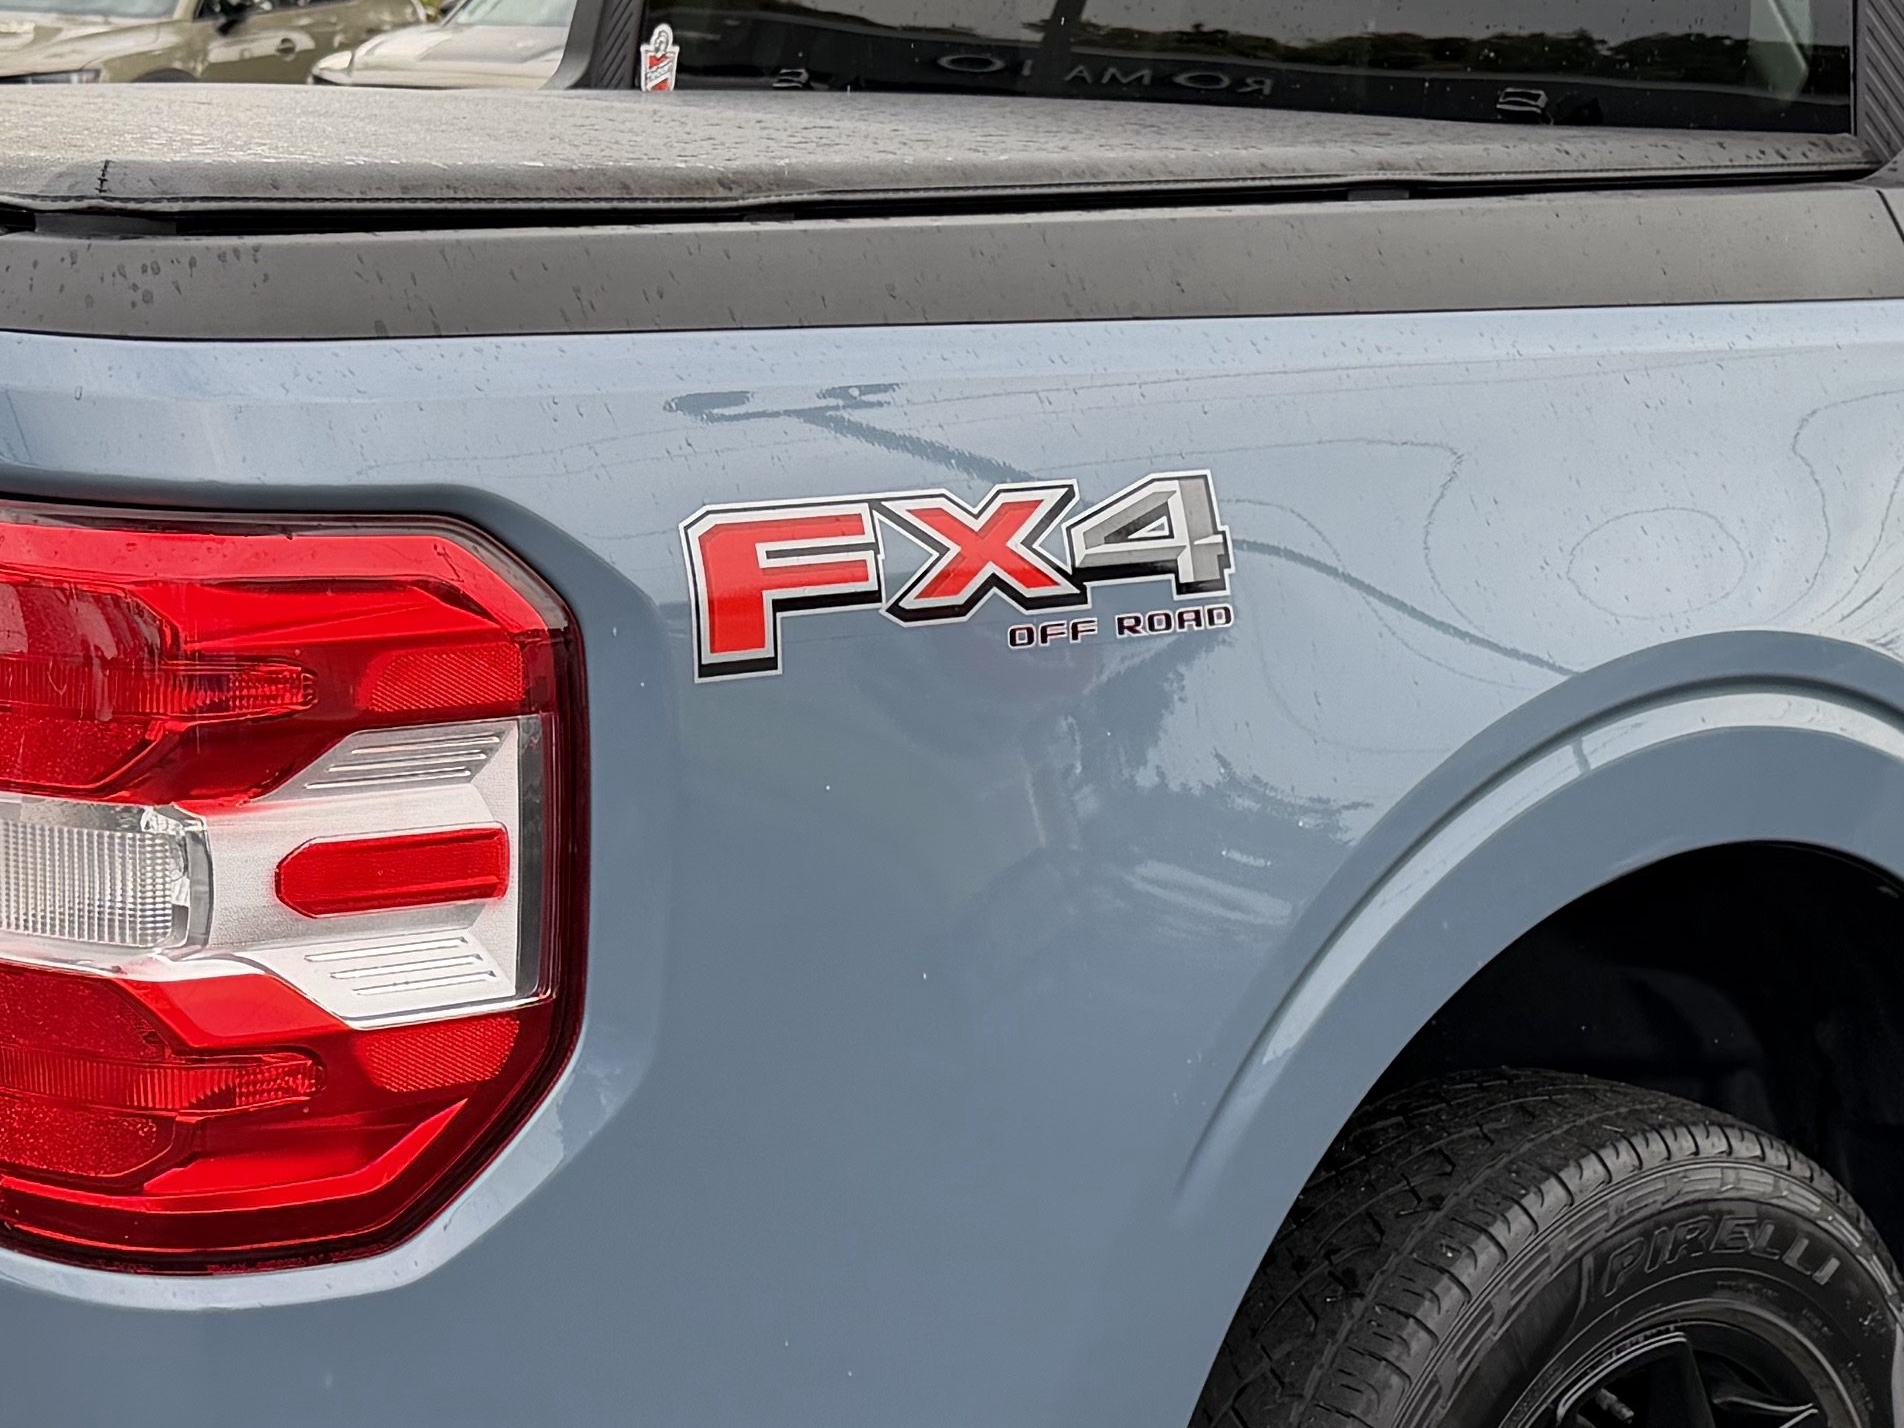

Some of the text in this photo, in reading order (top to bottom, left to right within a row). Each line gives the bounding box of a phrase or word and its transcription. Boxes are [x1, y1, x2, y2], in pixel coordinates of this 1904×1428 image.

[679, 469, 1235, 683] FX4
[1007, 603, 1235, 650] OFF ROAD
[1603, 1213, 1842, 1298] PIRELLI
